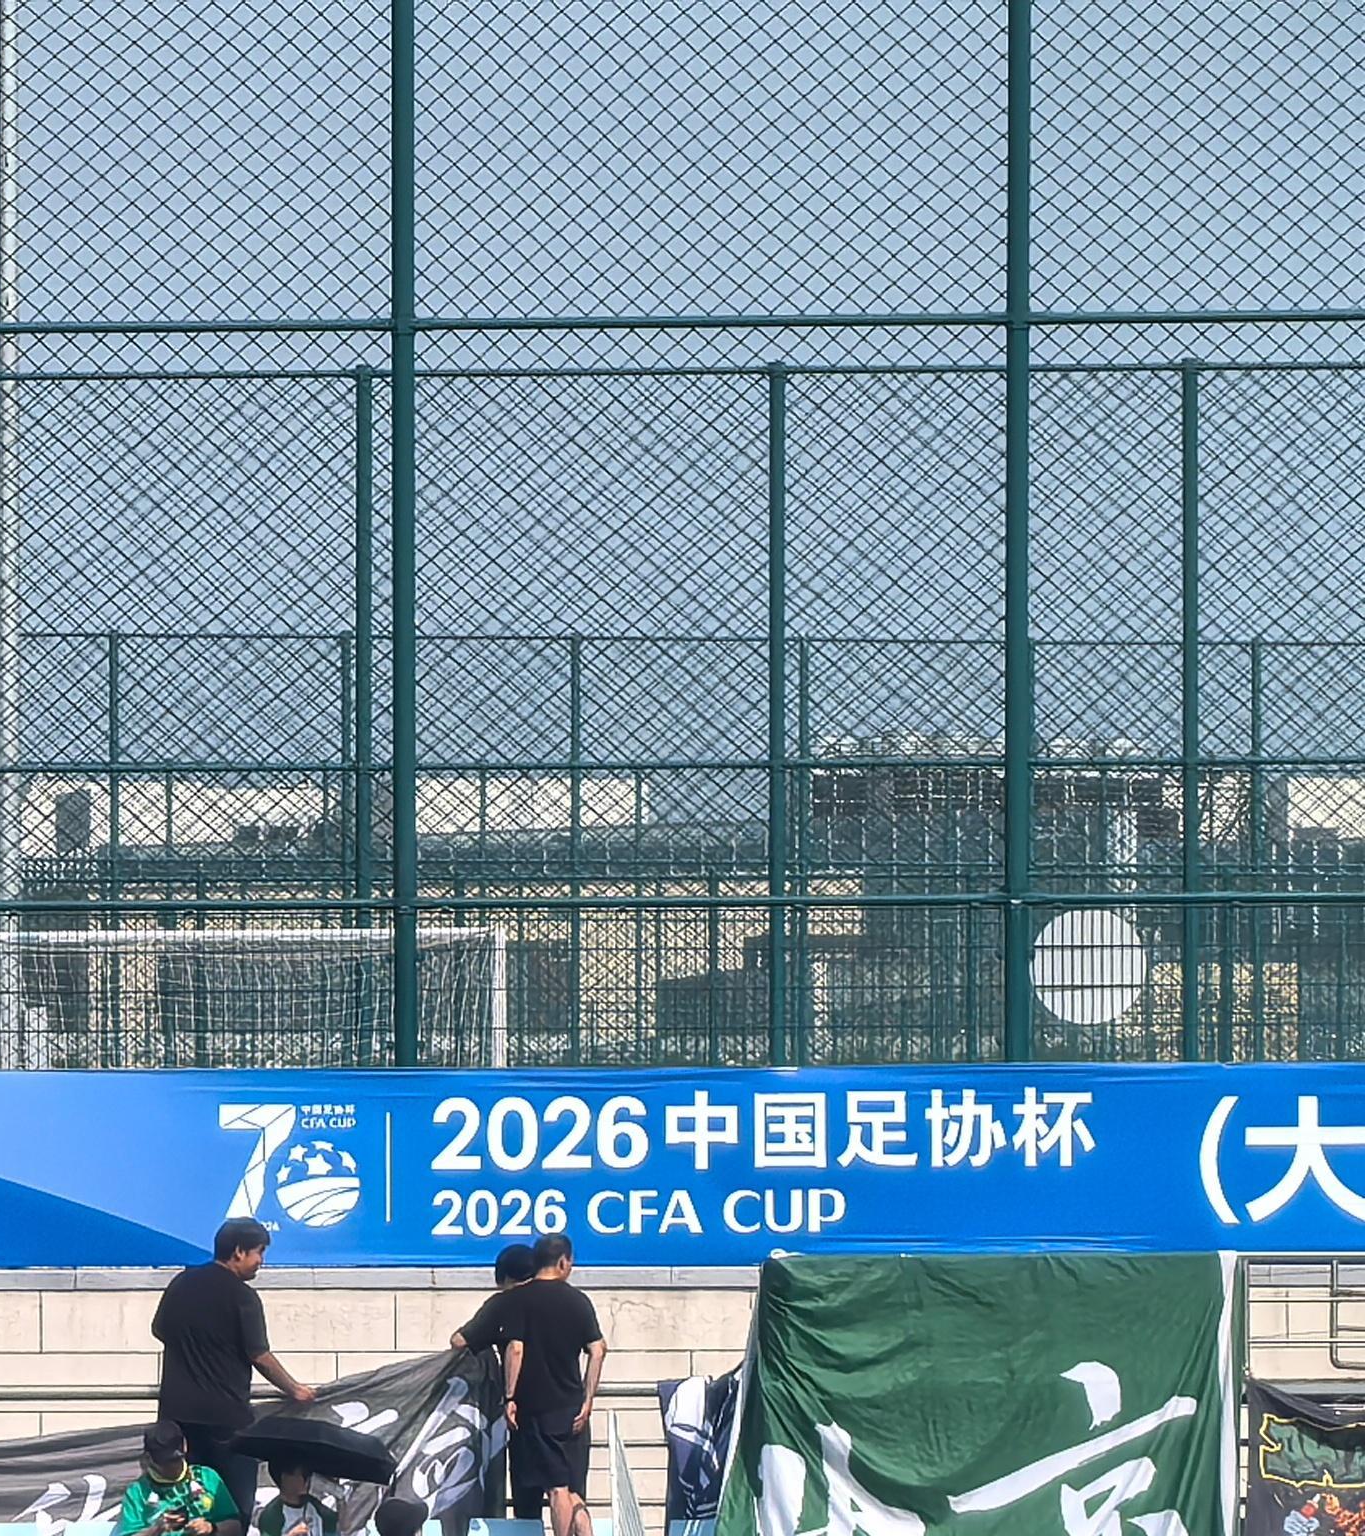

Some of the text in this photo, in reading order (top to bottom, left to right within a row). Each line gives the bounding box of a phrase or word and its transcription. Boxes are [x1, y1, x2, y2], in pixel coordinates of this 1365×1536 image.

[430, 1088, 1097, 1172] 2026中国足协杯
[431, 1186, 847, 1236] 2026 CFA CUP
